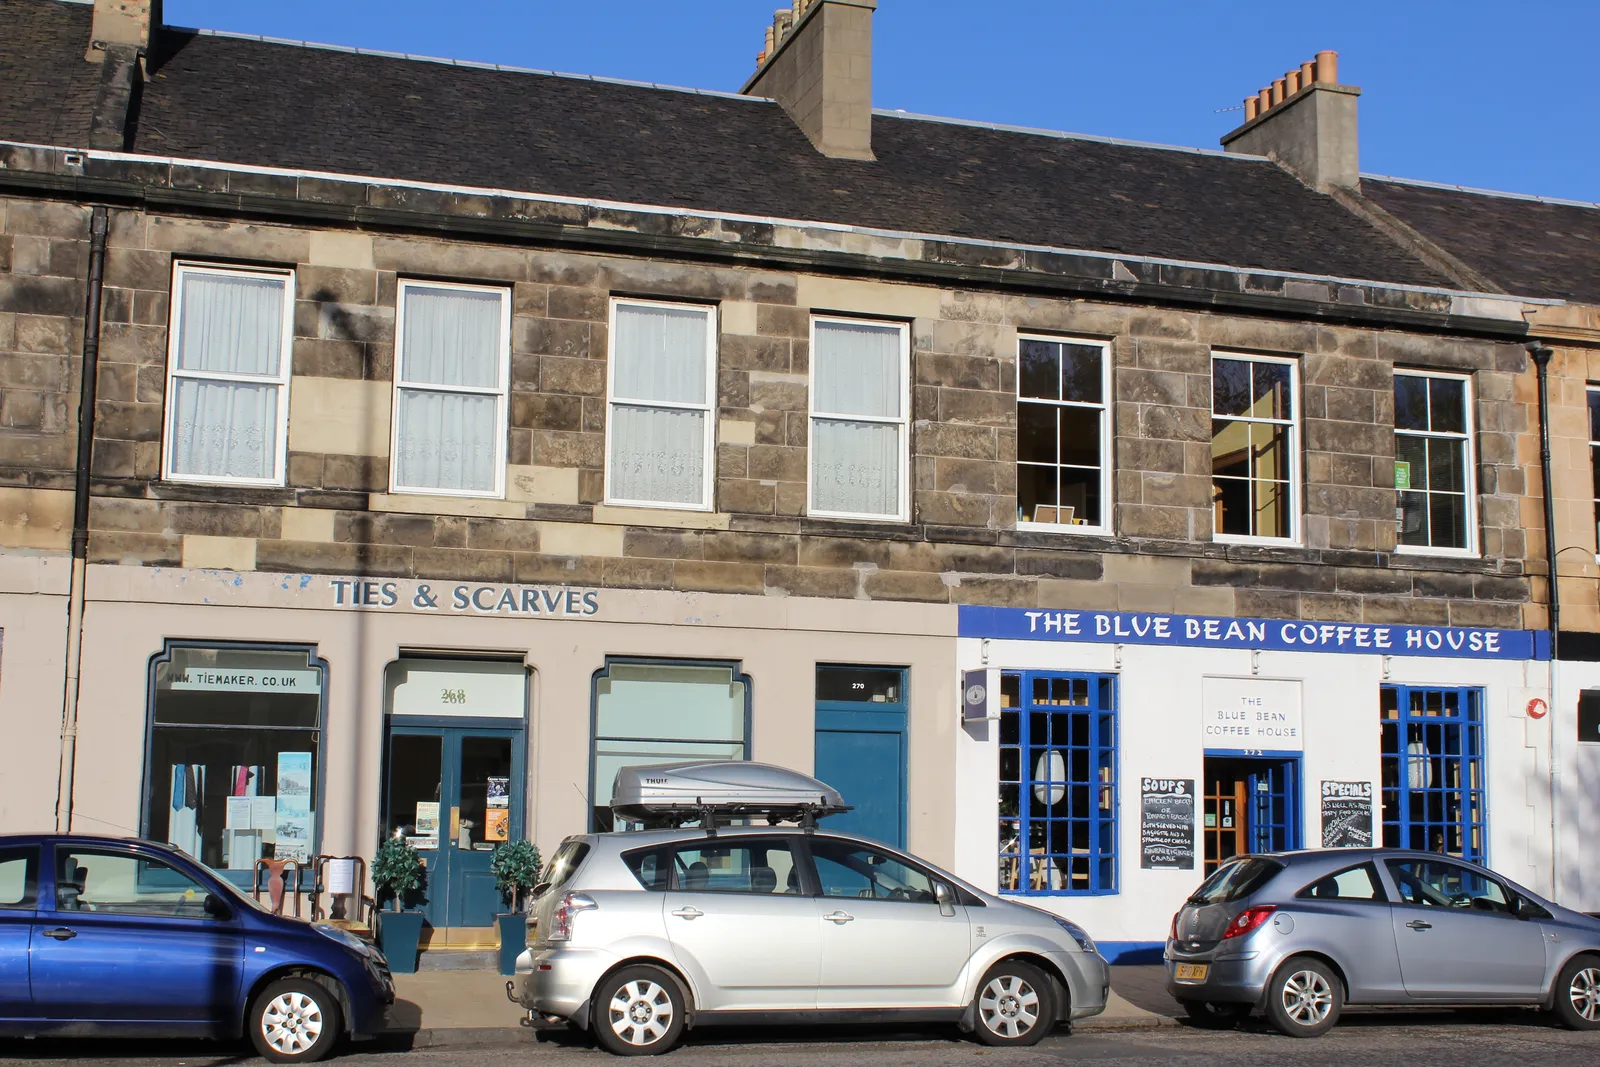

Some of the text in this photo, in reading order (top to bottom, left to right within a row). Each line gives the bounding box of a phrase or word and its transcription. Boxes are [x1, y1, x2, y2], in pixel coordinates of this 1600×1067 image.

[329, 580, 599, 616] TIES & SCARVES
[1024, 611, 1082, 634] THE
[1184, 618, 1266, 642] BEAN
[1281, 623, 1393, 648] COFFEE
[441, 689, 466, 704] 268
[1241, 697, 1262, 706] THE
[1218, 711, 1286, 721] BLUE BEAN
[1206, 725, 1296, 737] COFFEE HOUSE
[1142, 778, 1185, 794] SOUPS
[1322, 781, 1371, 796] SPECIALS
